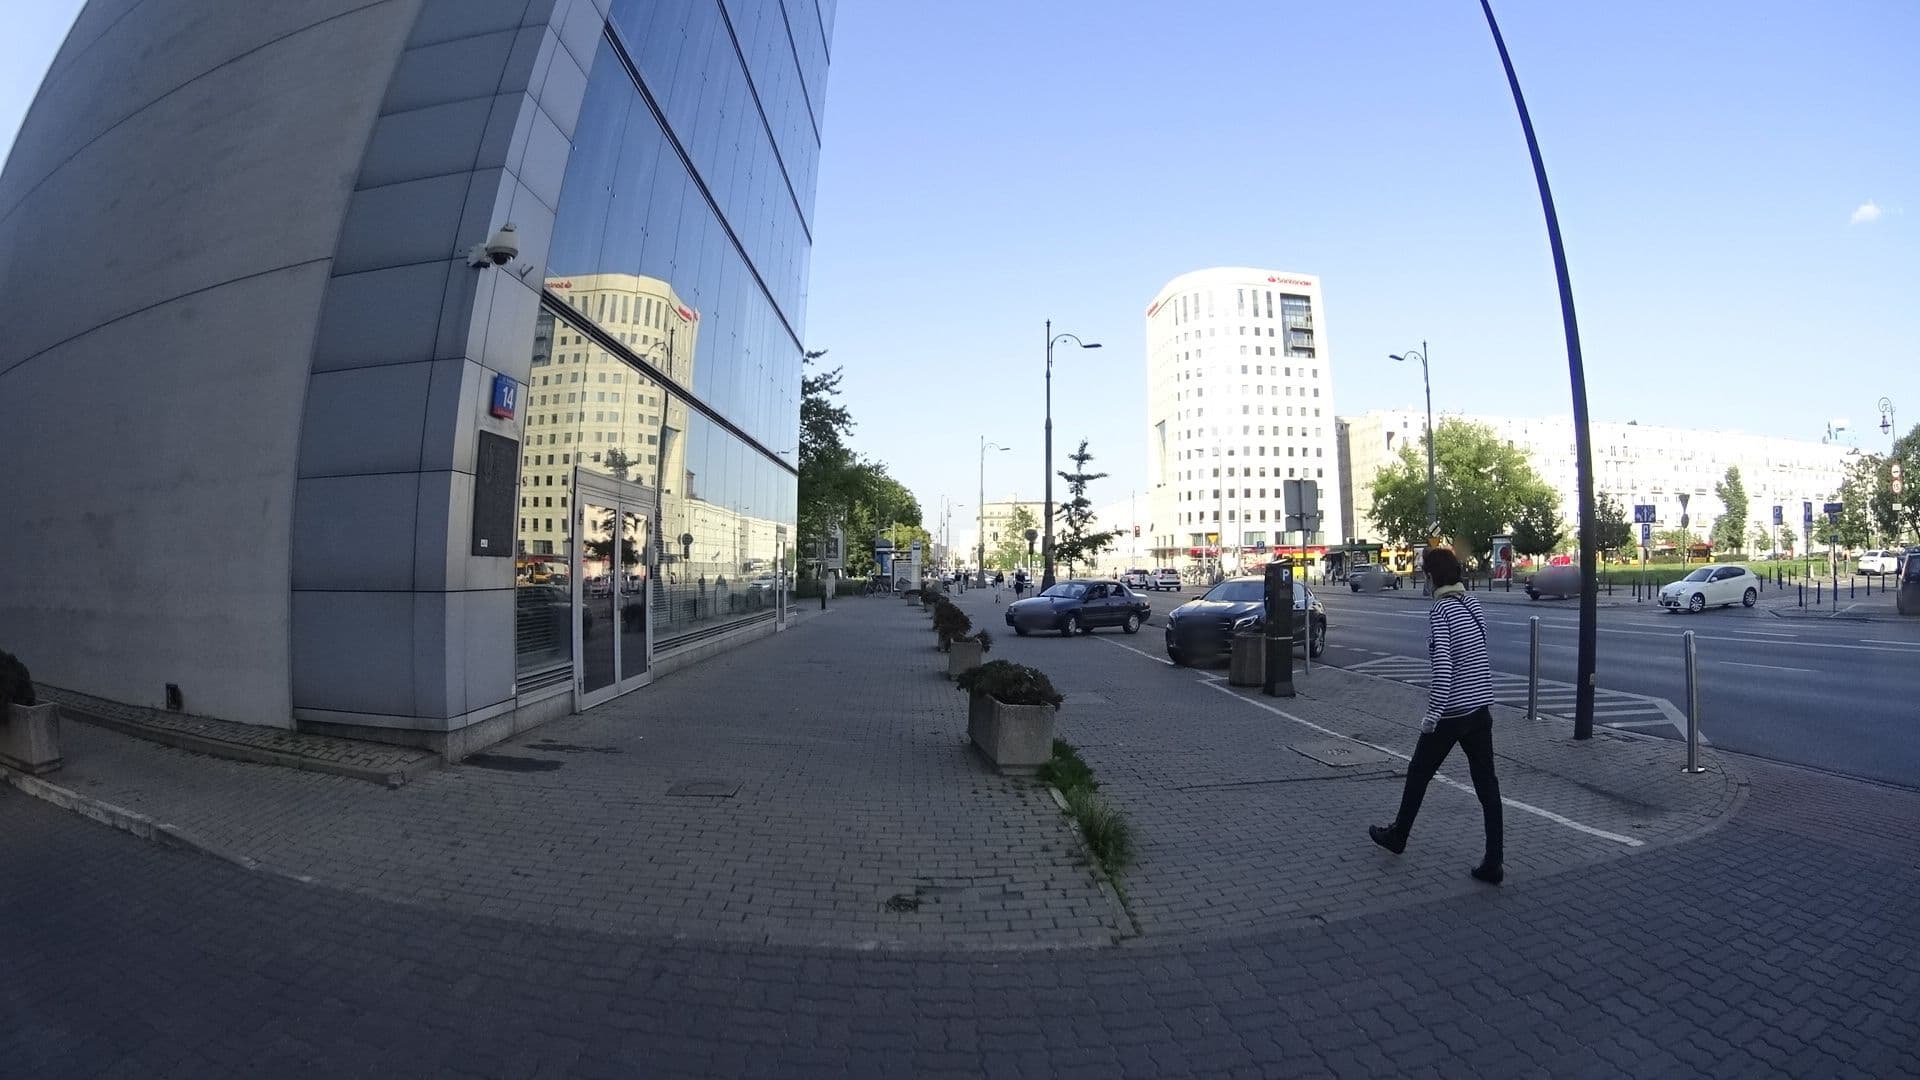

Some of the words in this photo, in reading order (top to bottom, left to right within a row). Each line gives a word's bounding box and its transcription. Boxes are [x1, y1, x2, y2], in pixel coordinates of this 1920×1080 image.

[503, 386, 514, 409] 14
[1643, 525, 1649, 539] P
[1282, 569, 1290, 582] P
